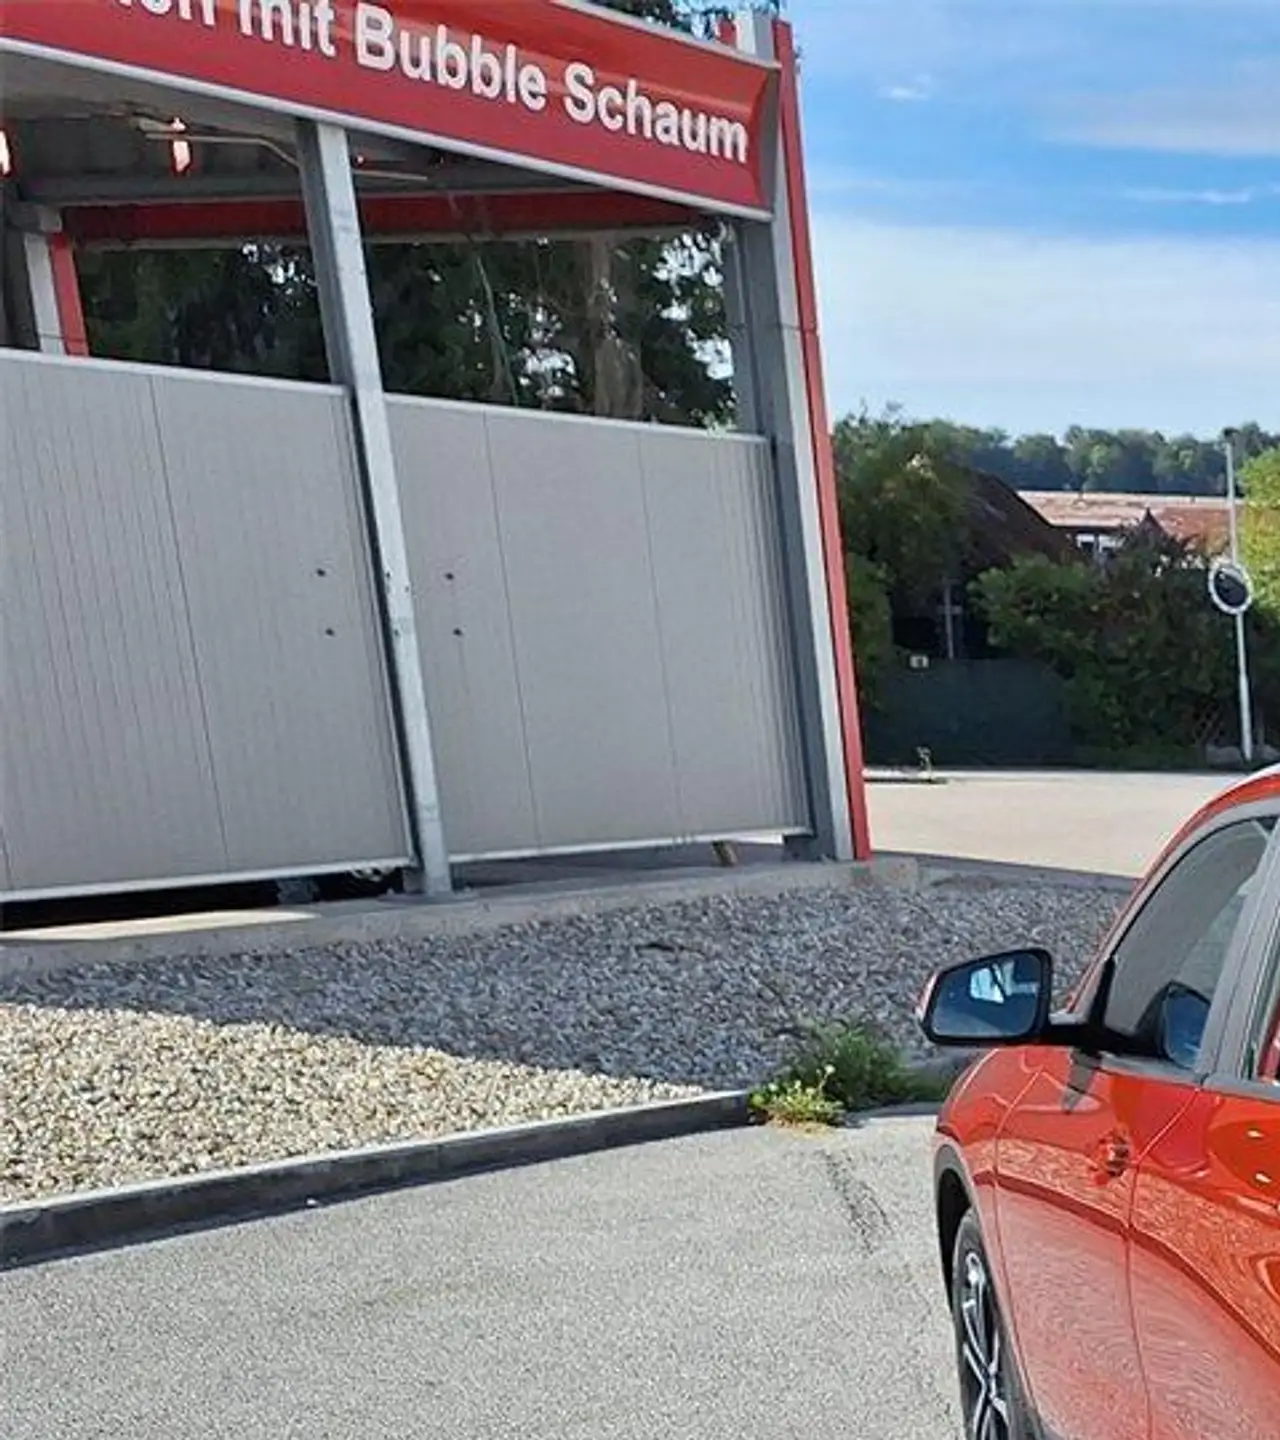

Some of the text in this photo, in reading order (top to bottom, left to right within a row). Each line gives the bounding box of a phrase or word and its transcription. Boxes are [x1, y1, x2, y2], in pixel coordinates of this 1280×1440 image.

[238, 0, 749, 164] mit Bubble Schaum
